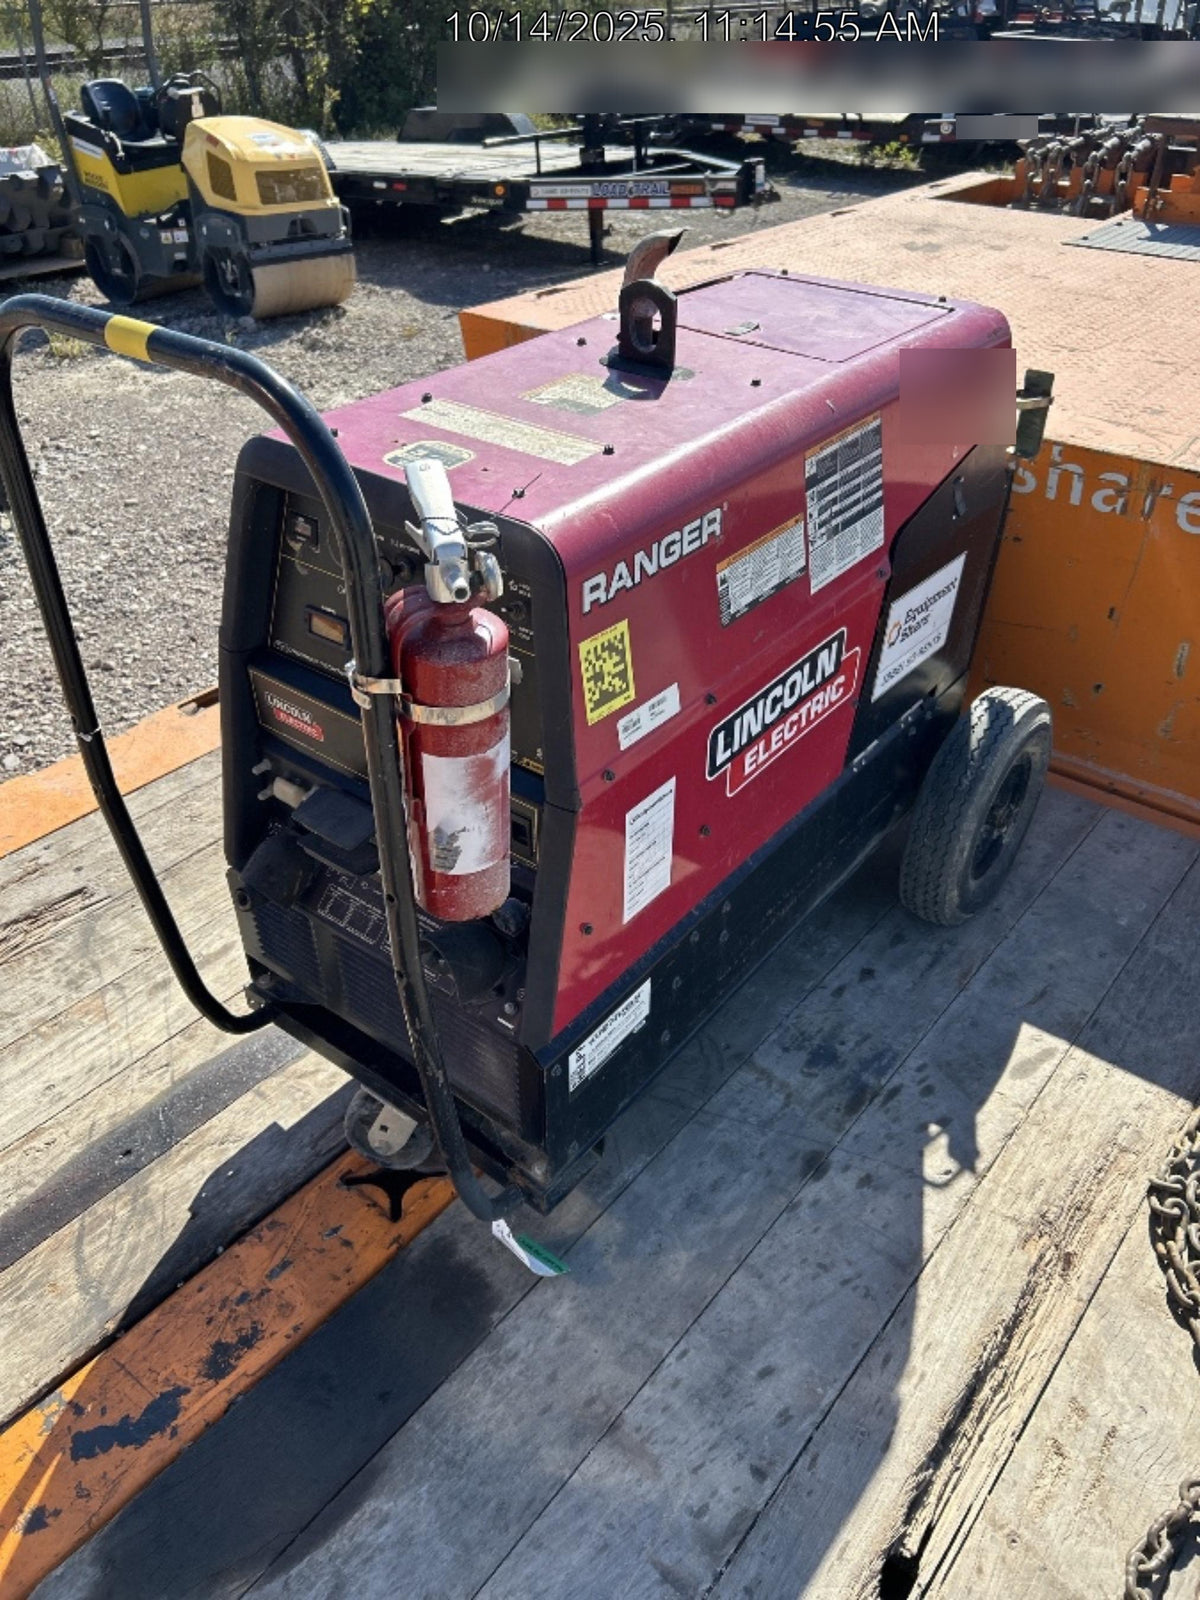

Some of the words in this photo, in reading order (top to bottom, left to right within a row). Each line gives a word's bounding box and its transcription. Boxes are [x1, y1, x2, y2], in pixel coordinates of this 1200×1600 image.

[592, 182, 628, 197] LOAD
[633, 181, 670, 197] TRAIL
[1010, 446, 1200, 535] share
[582, 507, 722, 614] RANGER
[715, 641, 838, 767] LINCOLN
[743, 674, 846, 776] ELECTRIC
